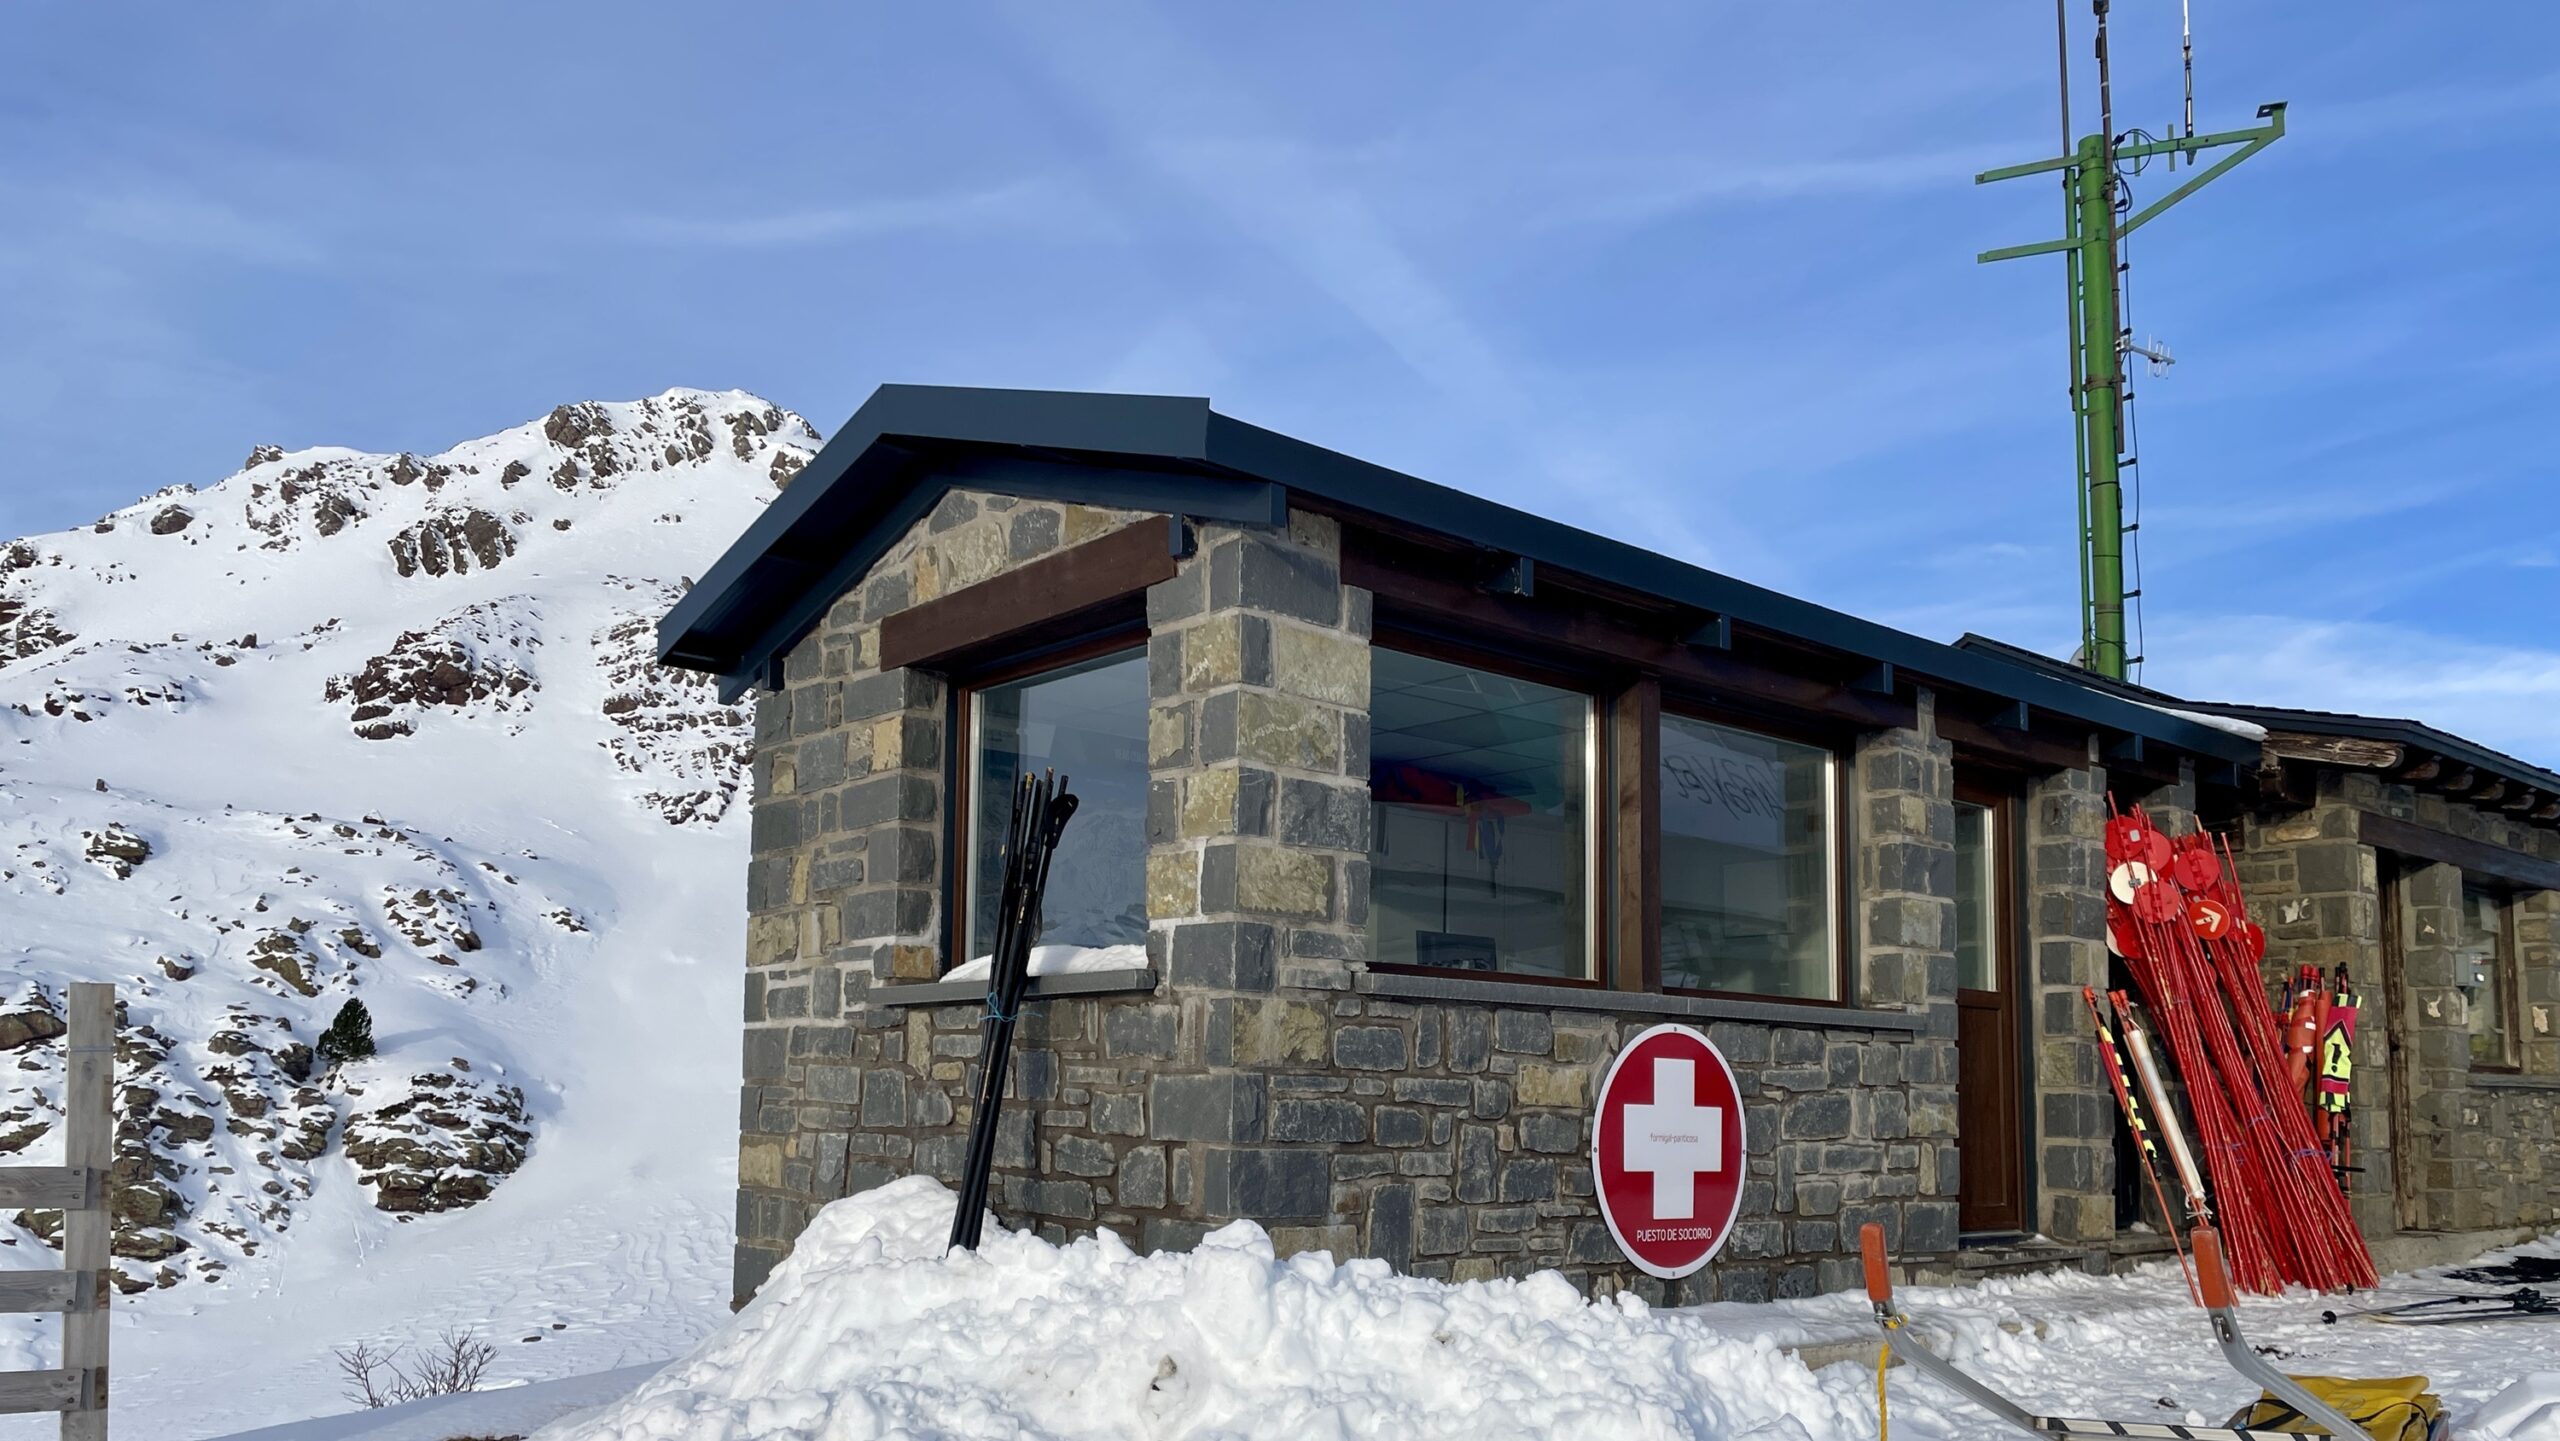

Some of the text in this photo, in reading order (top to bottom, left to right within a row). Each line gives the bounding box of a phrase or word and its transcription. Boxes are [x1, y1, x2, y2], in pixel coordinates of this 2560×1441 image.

[1636, 1227, 1712, 1242] PUESTO DE SOCORRO
